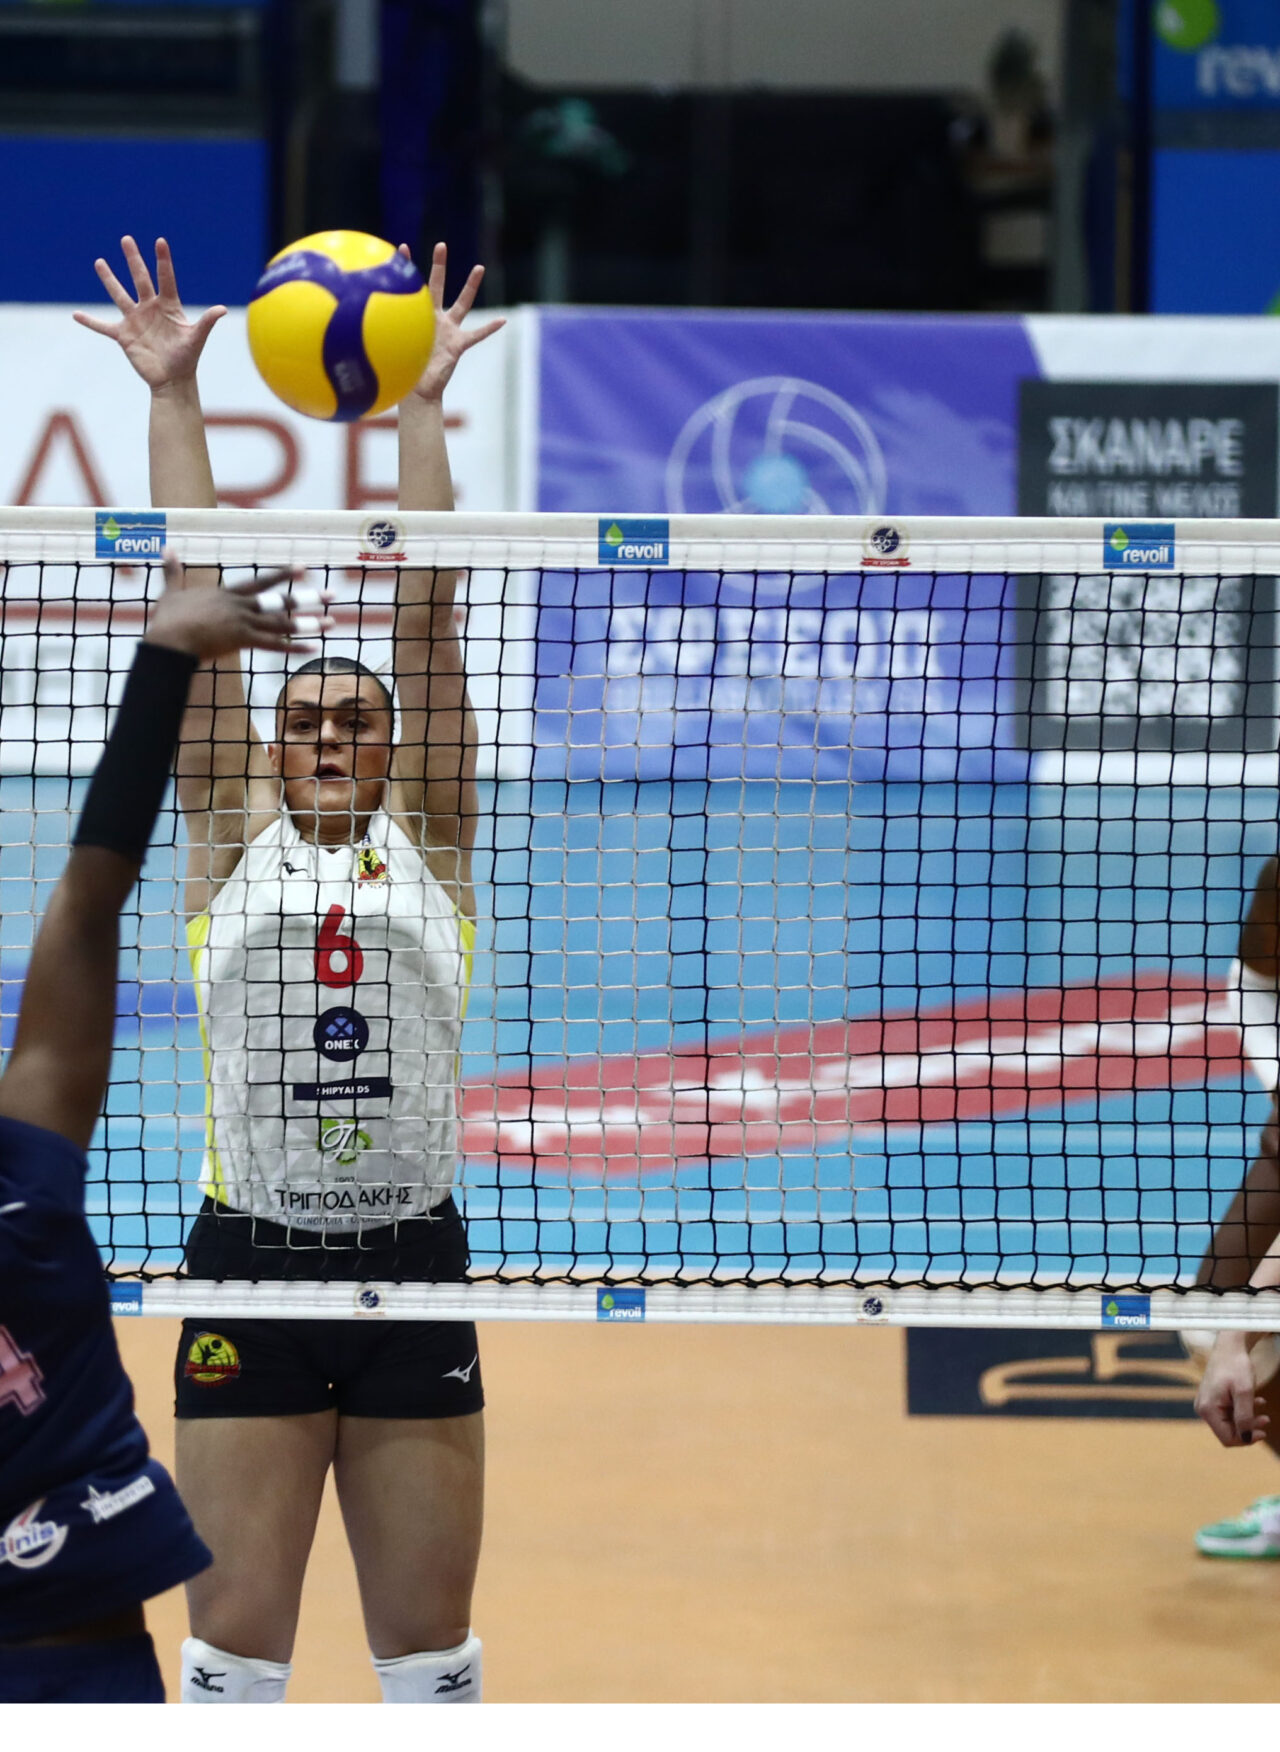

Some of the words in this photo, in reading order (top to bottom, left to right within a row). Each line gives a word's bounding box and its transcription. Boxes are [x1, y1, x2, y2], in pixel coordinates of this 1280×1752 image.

[1048, 416, 1245, 476] ΣΚΑΝΑΡΕ
[114, 537, 161, 553] revoil
[617, 543, 663, 559] revoil
[1122, 546, 1169, 563] revoil
[314, 904, 364, 989] 6
[274, 1186, 414, 1210] ΤΡΙΠΟΔΑΚΗΣ
[609, 1306, 642, 1318] revoil
[1114, 1314, 1147, 1326] revoil
